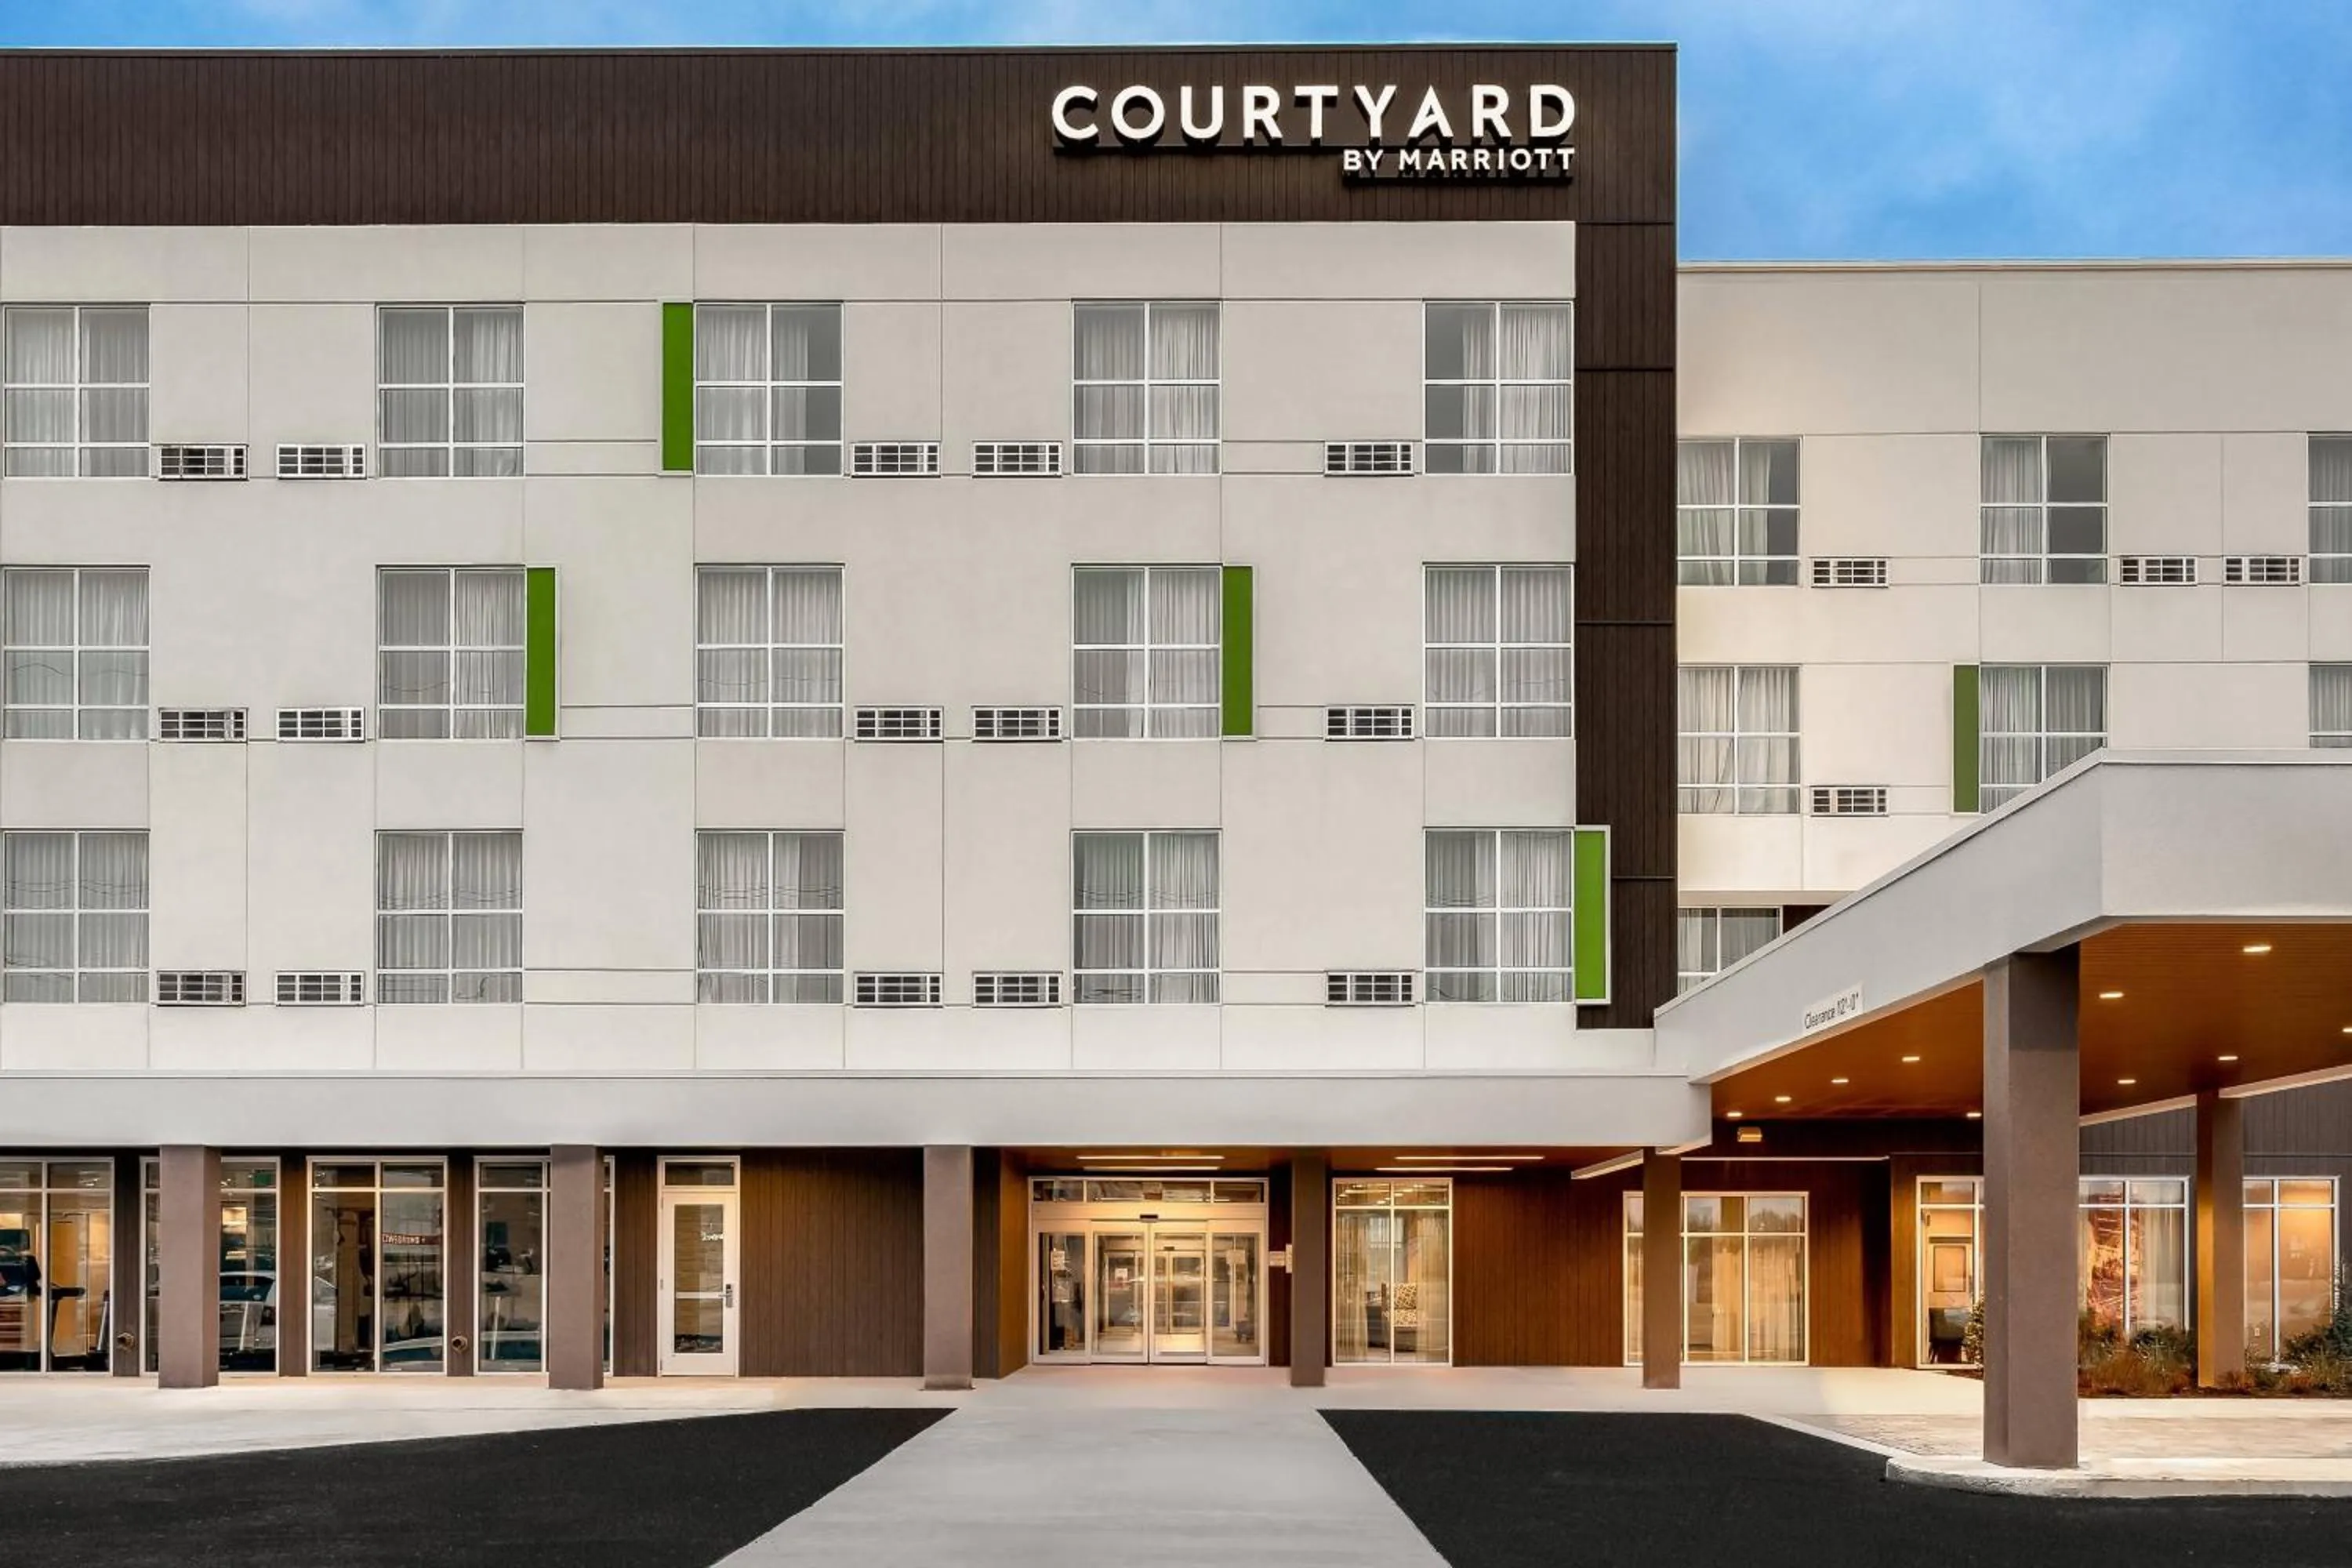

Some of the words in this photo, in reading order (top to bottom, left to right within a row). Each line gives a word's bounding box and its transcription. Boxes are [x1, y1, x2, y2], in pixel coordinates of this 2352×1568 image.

[1051, 84, 1576, 140] COURTYARD
[1343, 149, 1383, 171] BY
[1399, 147, 1576, 171] MARRIOTT
[1804, 1007, 1835, 1029] Clearance
